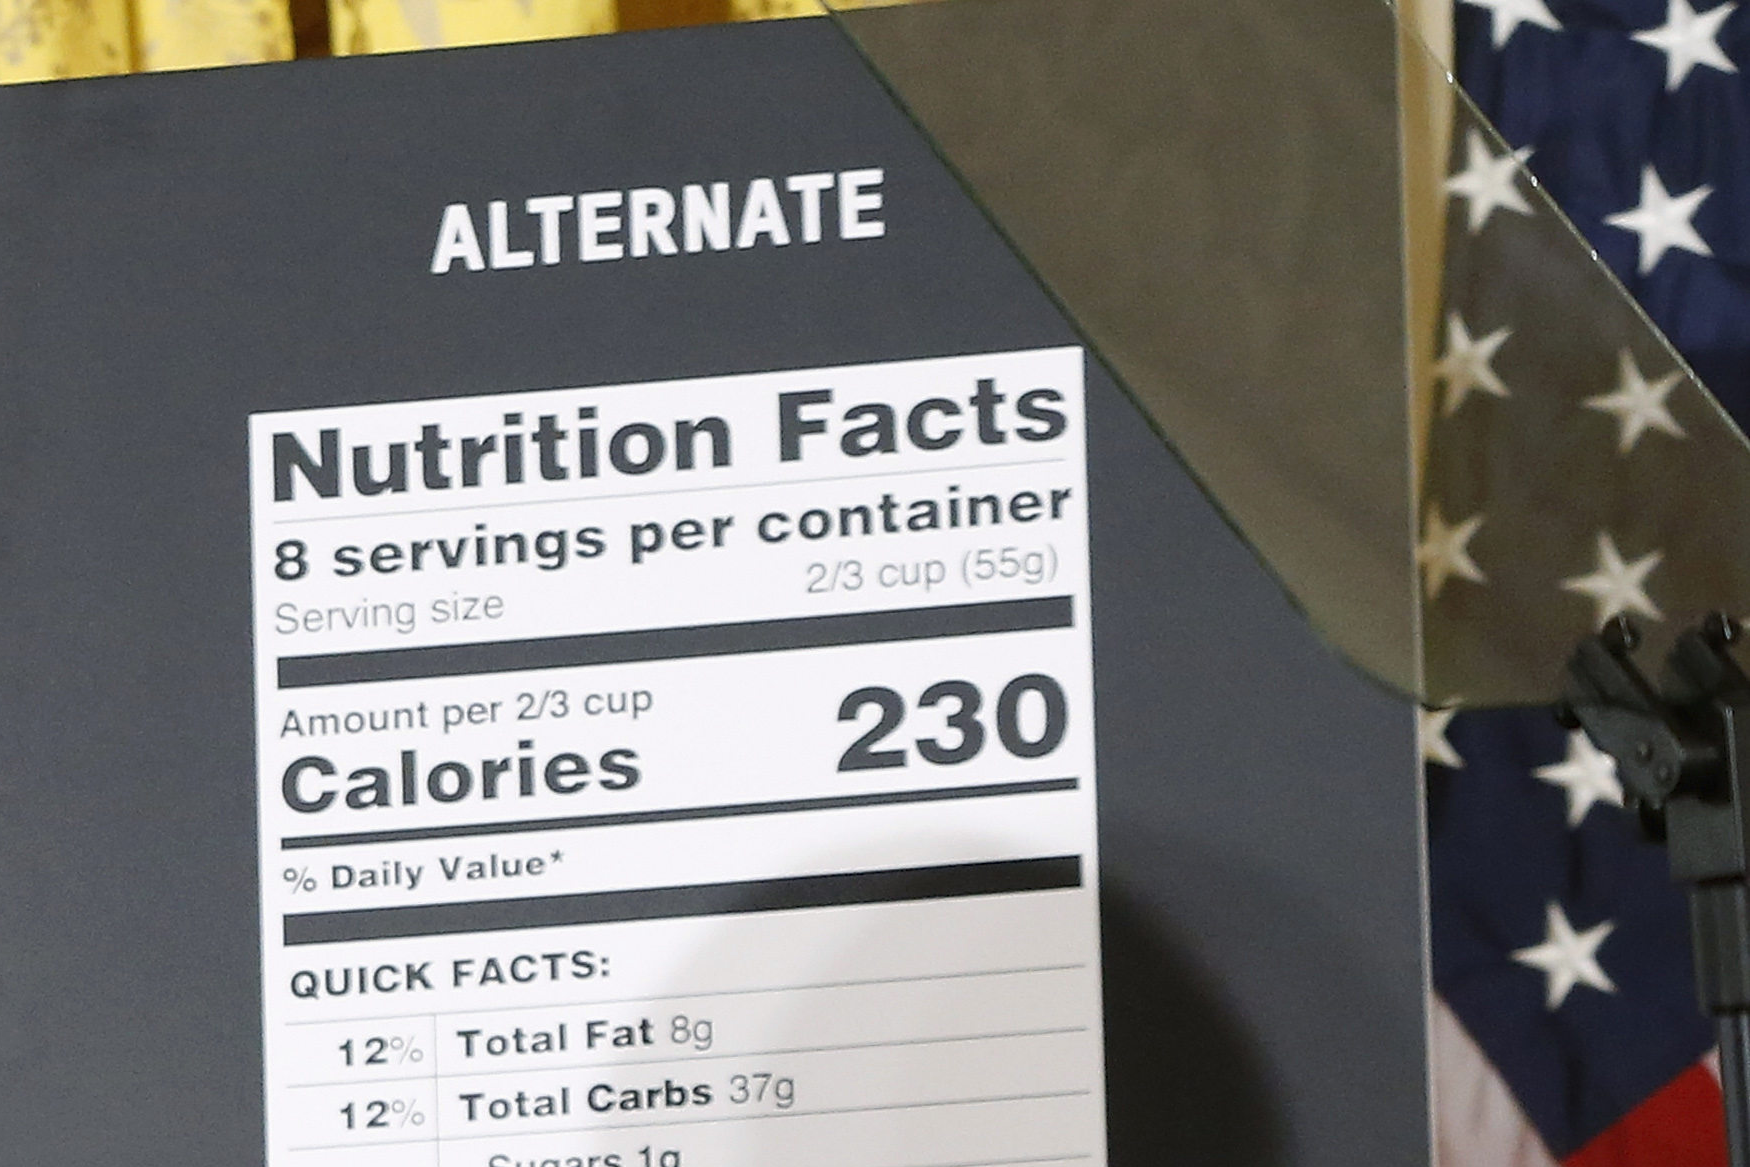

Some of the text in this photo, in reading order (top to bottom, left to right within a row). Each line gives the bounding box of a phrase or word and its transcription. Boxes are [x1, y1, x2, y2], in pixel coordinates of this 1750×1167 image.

[431, 169, 885, 273] ALTERNATE
[271, 378, 1067, 502] Nutrition Facts
[274, 485, 1071, 581] 8 servings per container
[275, 544, 1058, 635] Serving size 2/3 cup (55g)
[280, 690, 652, 738] Amount per 2/3 cup
[282, 673, 1068, 814] Calories 230
[283, 867, 317, 893] %
[332, 861, 422, 890] Daily
[291, 950, 609, 999] QUICK FACTS:
[339, 1015, 712, 1066] 12% Total Fat 8g
[341, 1073, 794, 1129] 12% Total Carbs 37g
